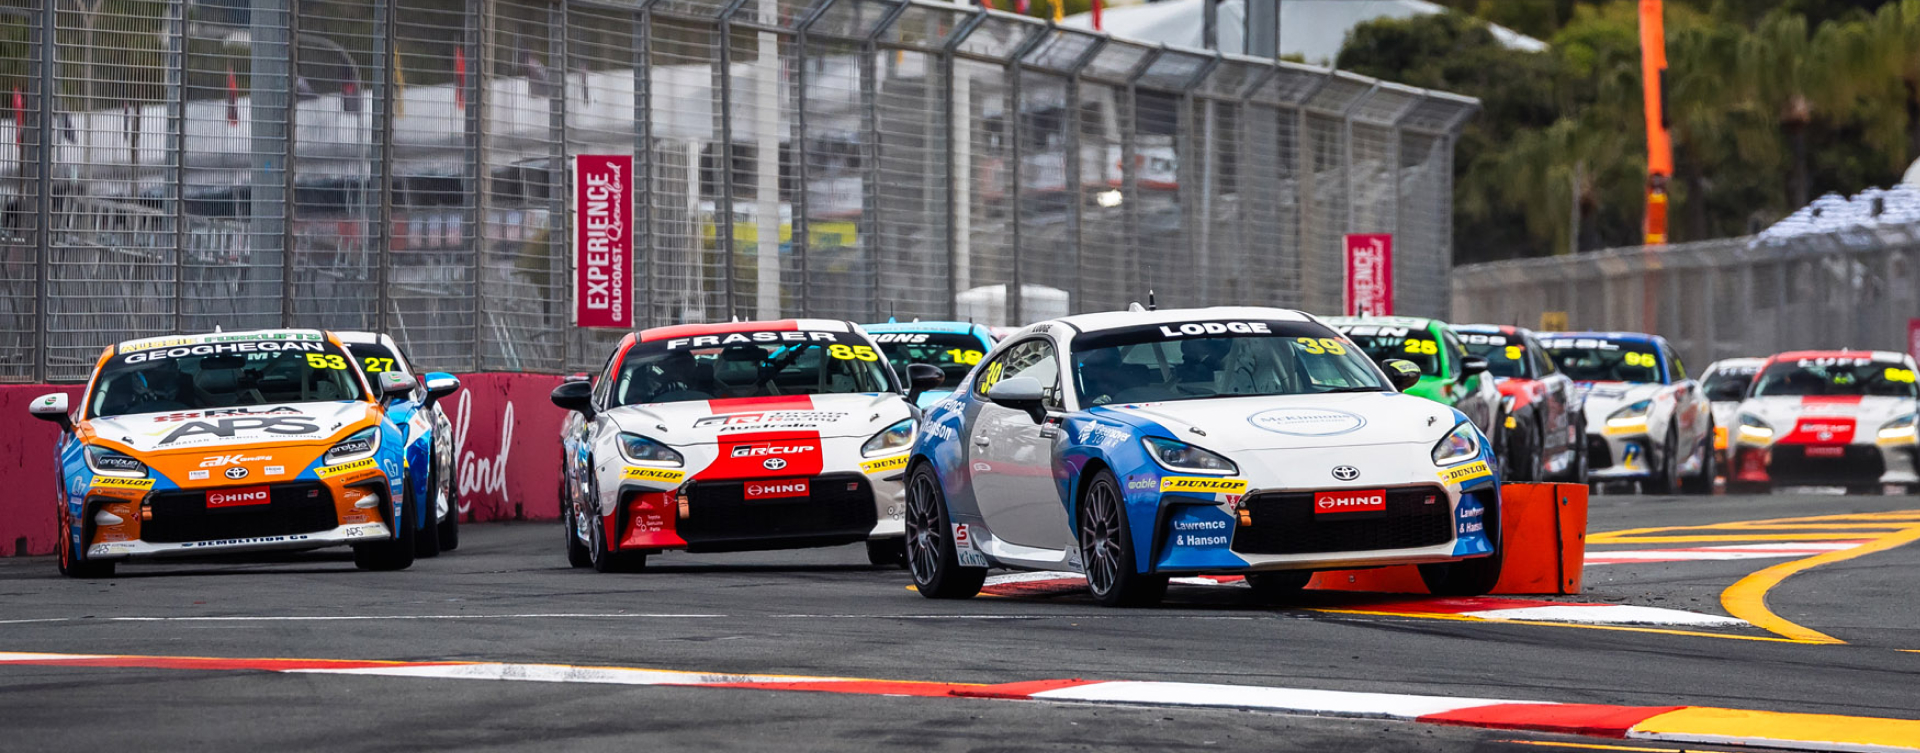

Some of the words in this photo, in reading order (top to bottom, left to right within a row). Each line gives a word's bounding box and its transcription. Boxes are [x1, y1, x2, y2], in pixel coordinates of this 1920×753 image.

[606, 162, 623, 241] Queensland
[587, 173, 609, 309] EXPERIENCE
[1353, 247, 1373, 315] RIENCE
[1159, 322, 1272, 337] LODGE
[667, 331, 837, 350] FRASER
[1297, 337, 1347, 356] 39
[1404, 338, 1438, 355] 25
[124, 342, 325, 364] GEOGHEGAN
[828, 344, 878, 361] 85
[948, 348, 983, 366] 18
[1504, 345, 1521, 359] 3
[306, 353, 348, 370] 53
[364, 357, 394, 372] 27
[981, 361, 1003, 394] 39
[157, 416, 321, 445] APS
[720, 423, 817, 431] Australia
[328, 459, 374, 473] DUNLOP
[873, 457, 909, 469] DUNLO
[630, 469, 682, 479] DUNLOP
[1450, 464, 1488, 479] DUNLOP
[100, 478, 152, 486] DUNLOP
[764, 484, 806, 494] HINO
[1175, 480, 1245, 489] DUNLOP
[226, 491, 267, 502] HINO
[1336, 496, 1382, 506] HINO
[1174, 520, 1226, 530] Lawrence
[1176, 535, 1184, 546] &
[1187, 535, 1227, 546] Hanson
